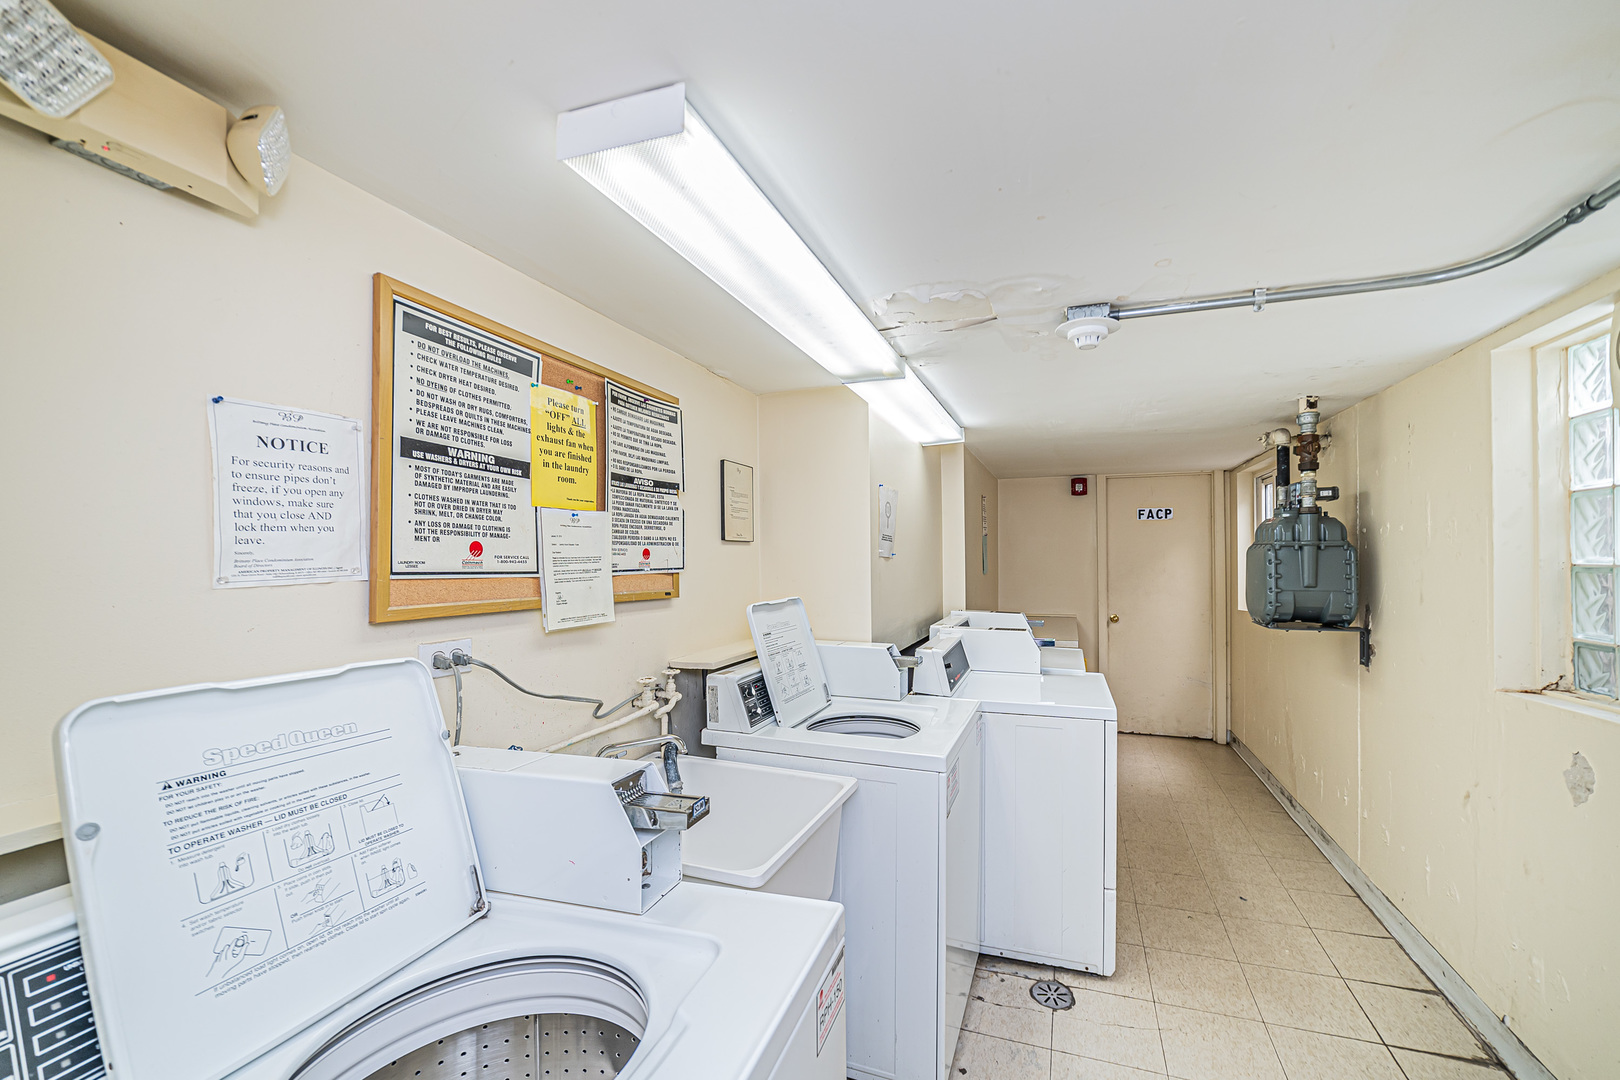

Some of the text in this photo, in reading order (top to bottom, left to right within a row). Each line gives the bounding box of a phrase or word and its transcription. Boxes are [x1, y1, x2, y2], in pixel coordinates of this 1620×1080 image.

[416, 352, 519, 392] CHECK WATER TEMPERATURE DESIRED.
[416, 364, 496, 395] CHECK DRYER HEAT DESIRED.
[416, 377, 511, 410] NO DYEING OF CLOTHES PERMITTED.
[416, 389, 528, 425] DO NOT WASH OR DRY RUGS, COMFORTERS,
[416, 398, 454, 414] BEDSPREADS
[464, 411, 483, 421] QUILTS
[491, 418, 505, 427] THESE
[547, 397, 584, 415] Please turn
[415, 407, 504, 435] PLEASE LEAVE MACHINES CLEAN.
[572, 416, 586, 426] ALL
[415, 419, 425, 427] WE
[427, 421, 438, 430] ARE
[440, 425, 451, 433] NOT
[453, 428, 488, 441] RESPONSIBLE
[415, 427, 424, 435] OR
[425, 429, 450, 440] DAMAGE
[460, 437, 485, 447] CLOTHES.
[546, 422, 585, 438] lights & the
[256, 434, 329, 454] NOTICE
[536, 432, 593, 452] exhaust fan when
[447, 447, 495, 464] WARNING
[539, 447, 591, 463] you are finished
[231, 455, 349, 474] For security reasons and
[414, 464, 430, 473] MOST
[463, 472, 490, 482] GARMENTS
[542, 459, 589, 476] in the laundry
[231, 469, 242, 478] to
[245, 471, 280, 481] ensure
[283, 473, 309, 485] pipes
[423, 474, 453, 483] SYNTHETIC
[455, 478, 479, 487] MATERIAL
[502, 485, 517, 493] EASILY
[557, 475, 576, 484] room.
[633, 477, 653, 486] AVISO
[232, 482, 344, 499] freeze, if you open any
[414, 480, 442, 489] DAMAGED
[451, 485, 478, 494] IMPROPER
[479, 489, 510, 498] LAUNDERING.
[232, 495, 284, 507] windows,
[288, 498, 313, 507] make
[414, 493, 439, 501] CLOTHES
[441, 496, 463, 504] WASHED
[471, 499, 488, 507] WATER
[233, 509, 332, 521] that you close AND
[414, 508, 437, 516] SHRINK,
[1138, 509, 1172, 519] FACP
[234, 522, 257, 531] lock
[260, 523, 287, 531] them
[290, 523, 314, 531] when
[234, 535, 264, 544] leave.
[202, 722, 358, 766] Speed Queen
[175, 770, 227, 787] WARNING
[158, 793, 175, 802] FOR
[176, 788, 195, 798] YOUR
[174, 811, 203, 824] REDUCE
[204, 807, 217, 816] THE
[218, 803, 233, 812] RISK
[168, 793, 347, 855] TO OPERATE WASHER LID MUST BE CLOSED
